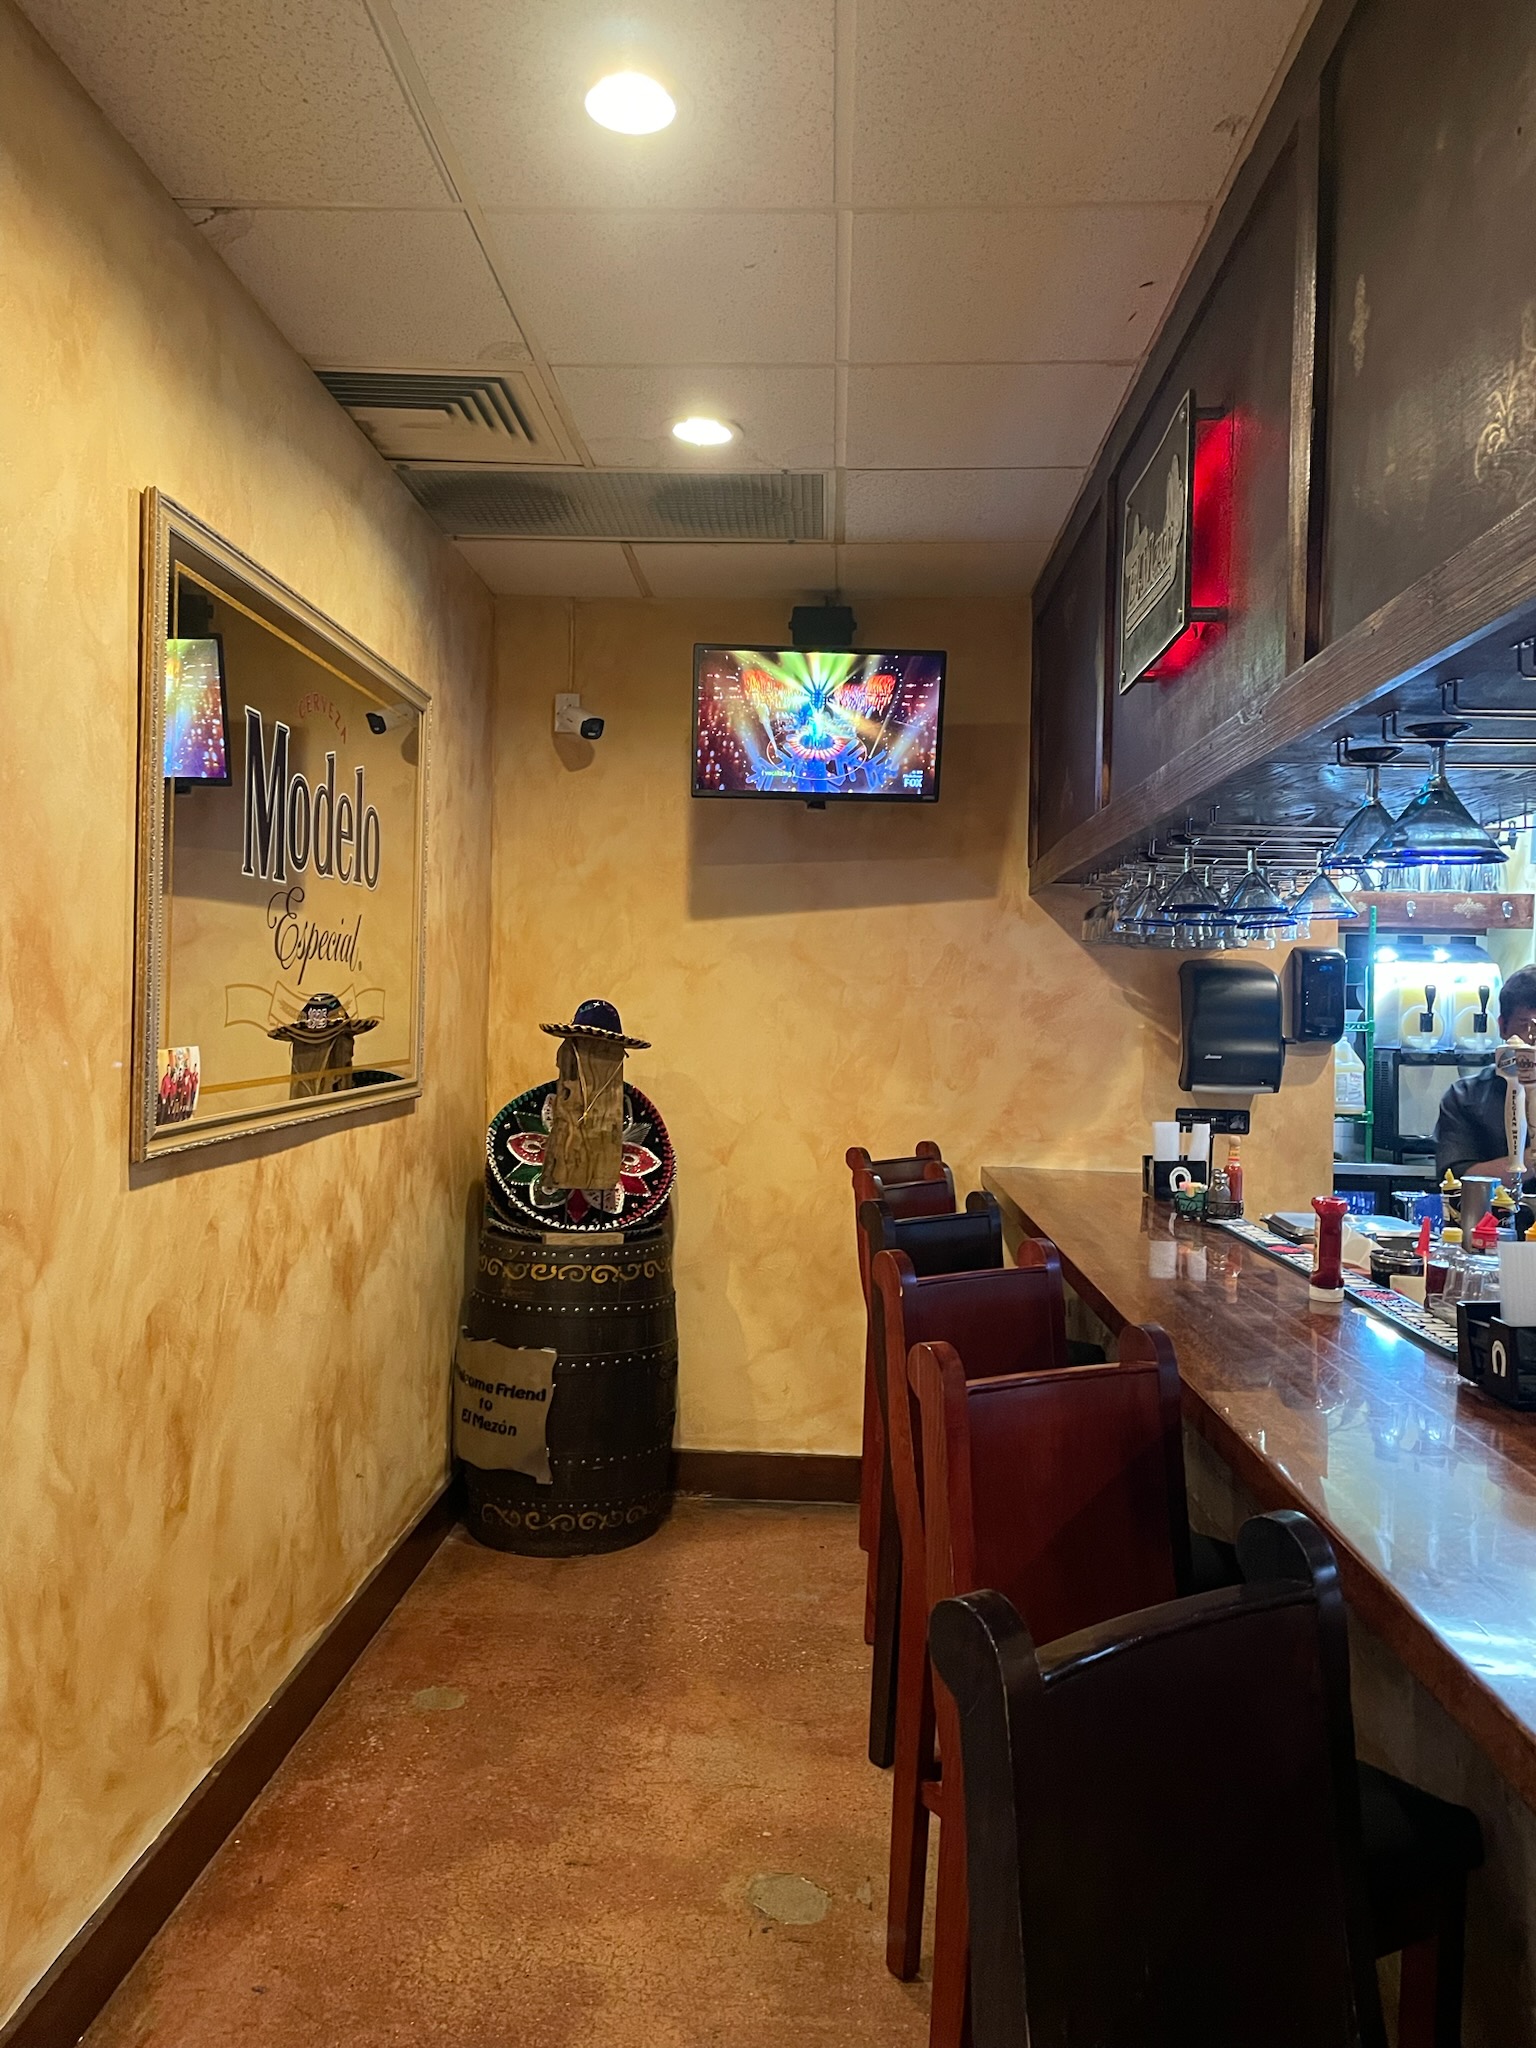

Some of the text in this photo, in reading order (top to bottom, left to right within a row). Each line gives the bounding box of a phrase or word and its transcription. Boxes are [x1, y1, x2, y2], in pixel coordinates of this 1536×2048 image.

[298, 692, 347, 745] CERVEZA
[903, 778, 924, 788] FOX
[242, 704, 381, 891] Modelo
[266, 886, 362, 986] Especial
[1511, 1129, 1519, 1156] WHITE
[479, 1397, 493, 1412] to
[495, 1382, 547, 1403] Friend
[461, 1408, 517, 1437] El Mezón
